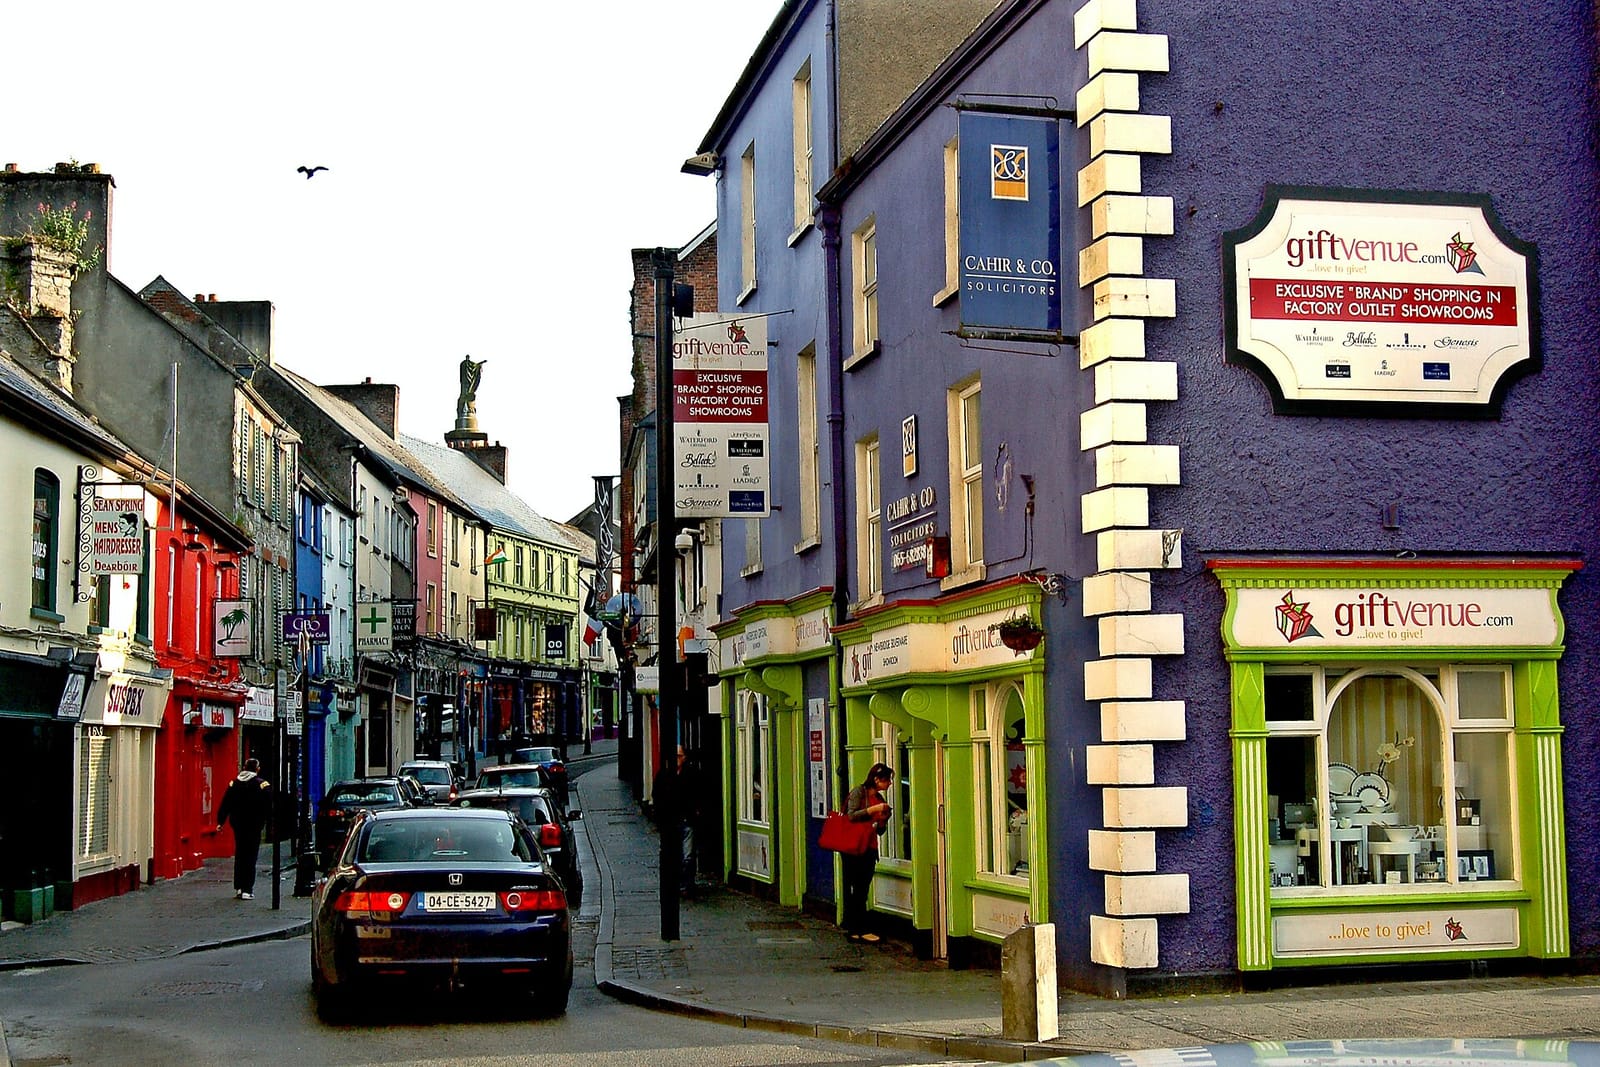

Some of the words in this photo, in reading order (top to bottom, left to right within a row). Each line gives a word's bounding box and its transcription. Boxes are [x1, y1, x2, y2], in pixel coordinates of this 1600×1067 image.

[1287, 230, 1446, 267] giftvenue.com
[965, 255, 1012, 273] CAHIR
[1016, 259, 1027, 274] &
[1031, 260, 1057, 276] CO.
[1335, 264, 1344, 273] to
[967, 281, 1055, 296] SOLICITORS
[1275, 283, 1344, 298] EXCLUSIVE
[1348, 286, 1408, 300] "BRAND"
[1413, 288, 1482, 303] SHOPPING
[1487, 290, 1501, 304] IN
[1284, 300, 1343, 315] FACTORY
[1348, 302, 1396, 316] OUTLET
[1401, 303, 1494, 319] SHOWROOMS
[673, 338, 765, 359] giftvenue.com
[1433, 336, 1480, 349] Genesis
[697, 374, 742, 383] EXCLUSIVE
[716, 385, 763, 394] SHOPPING
[676, 396, 687, 405] IN
[690, 396, 729, 405] FACTORY
[732, 396, 764, 405] OUTLET
[689, 407, 752, 416] SHOWROOMS
[93, 500, 116, 512] SEAN
[116, 500, 143, 512] SPRING
[676, 497, 723, 509] Genesis
[886, 496, 910, 522] CAHIR
[910, 493, 918, 512] &
[94, 522, 119, 534] MENS
[890, 521, 934, 548] SOLICITORS
[93, 538, 141, 556] HAIRDRESSER
[1334, 592, 1513, 637] giftvenue.com
[358, 637, 390, 646] PHARMACY
[1356, 629, 1384, 639] ...love
[1387, 630, 1397, 640] to
[1400, 629, 1424, 641] give!
[429, 896, 491, 907] 04-CE-5427
[1329, 923, 1370, 939] ...love
[1376, 924, 1391, 937] to
[1396, 920, 1431, 940] give!
